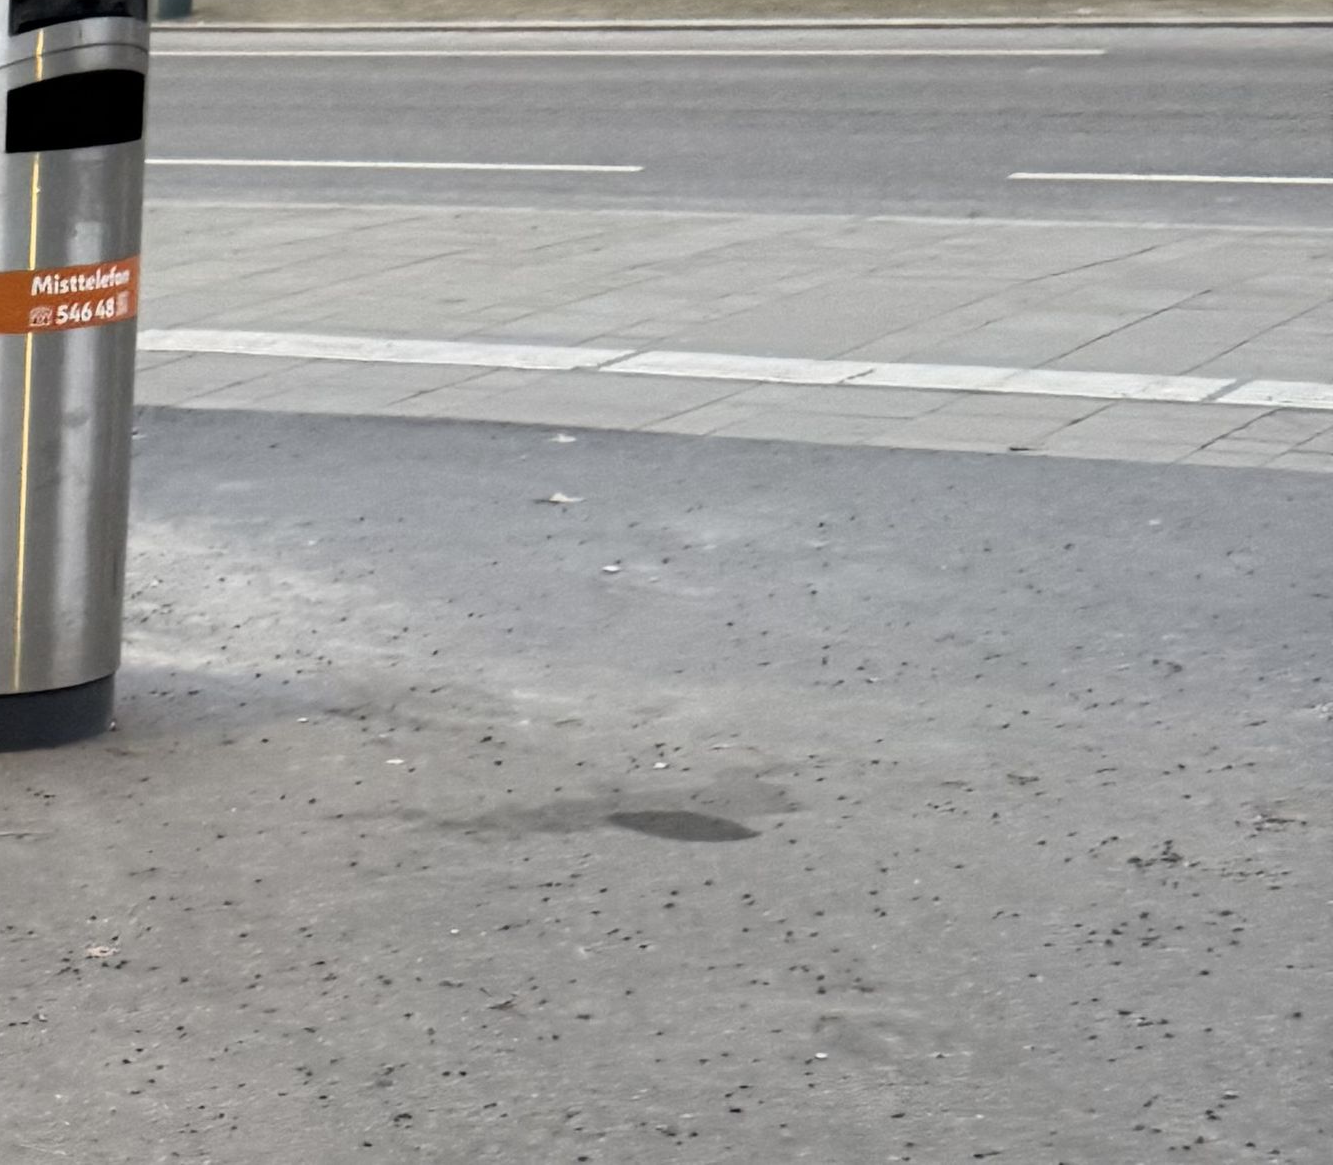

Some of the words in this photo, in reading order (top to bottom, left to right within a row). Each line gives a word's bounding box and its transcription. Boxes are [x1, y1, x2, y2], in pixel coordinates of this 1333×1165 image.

[31, 265, 131, 296] Misttelefon
[55, 301, 93, 325] 546
[94, 296, 115, 320] 48
